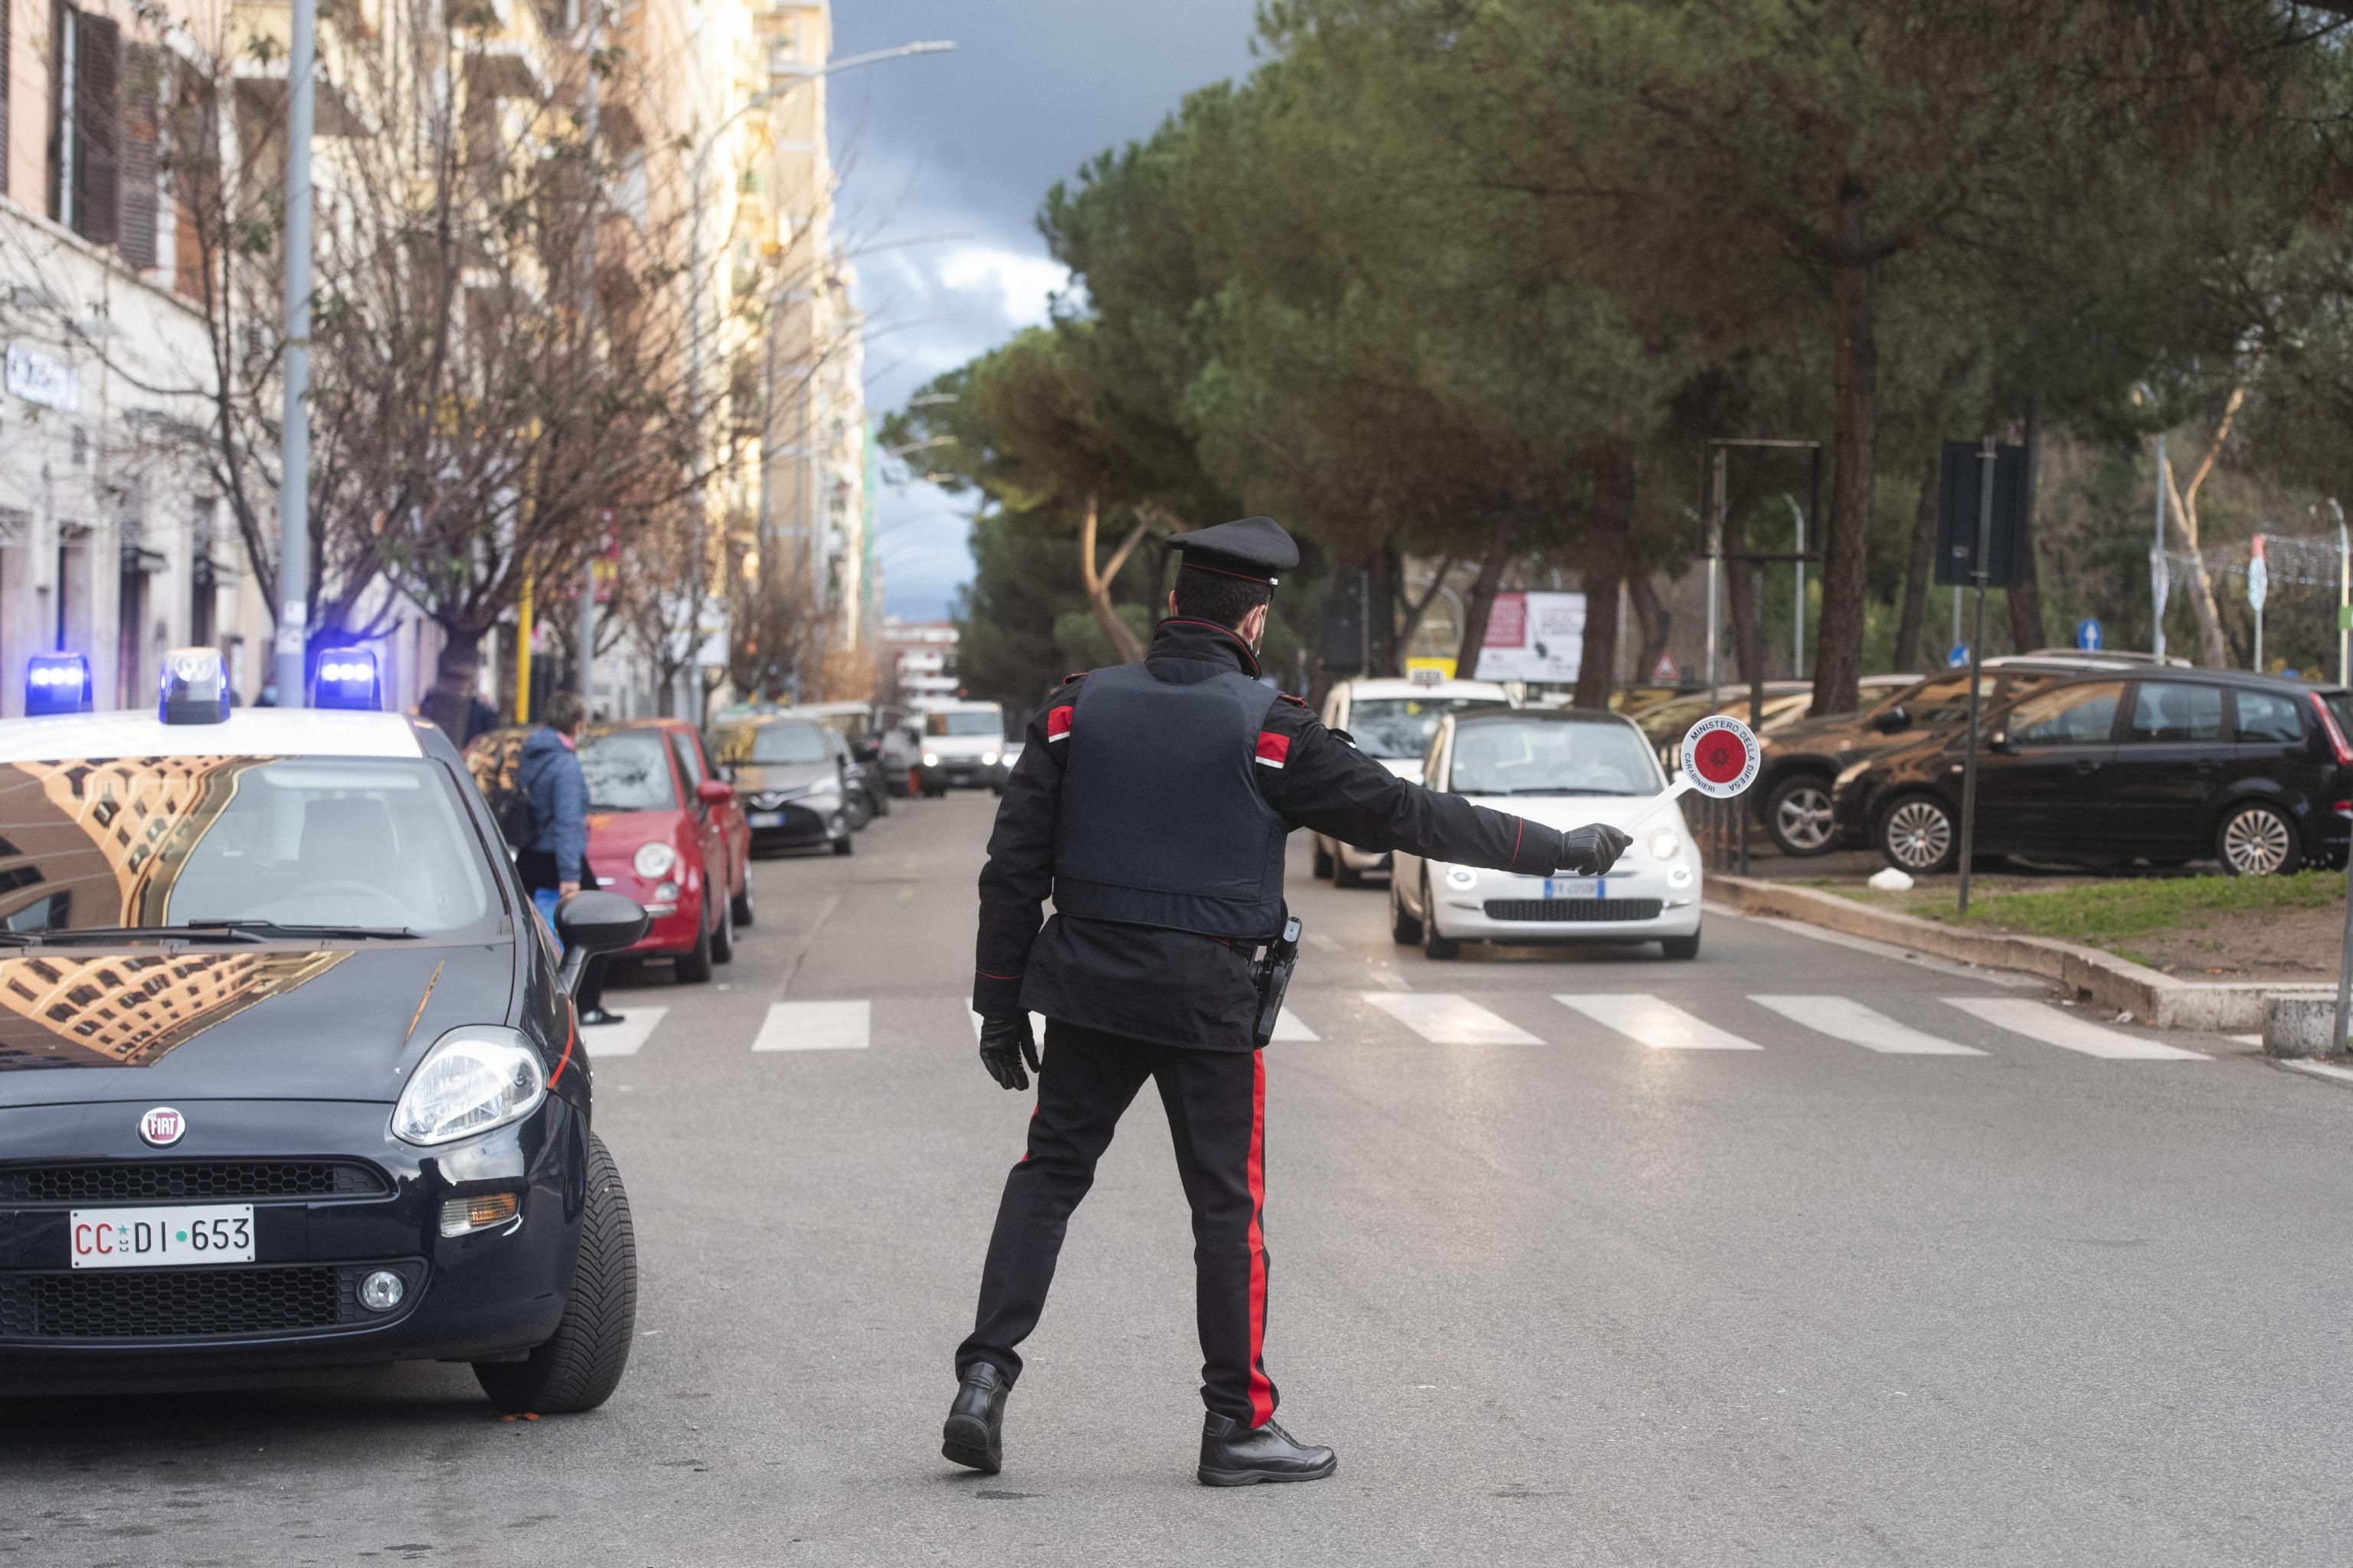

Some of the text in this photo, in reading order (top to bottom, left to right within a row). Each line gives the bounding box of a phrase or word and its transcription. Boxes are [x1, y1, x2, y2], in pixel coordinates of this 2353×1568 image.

[1684, 753, 1716, 793] CARABINIERI
[1690, 720, 1756, 791] MINISTERO DELLA DIFESA
[151, 1117, 176, 1135] FIAT
[75, 1223, 113, 1255] CC
[191, 1218, 250, 1250] 653
